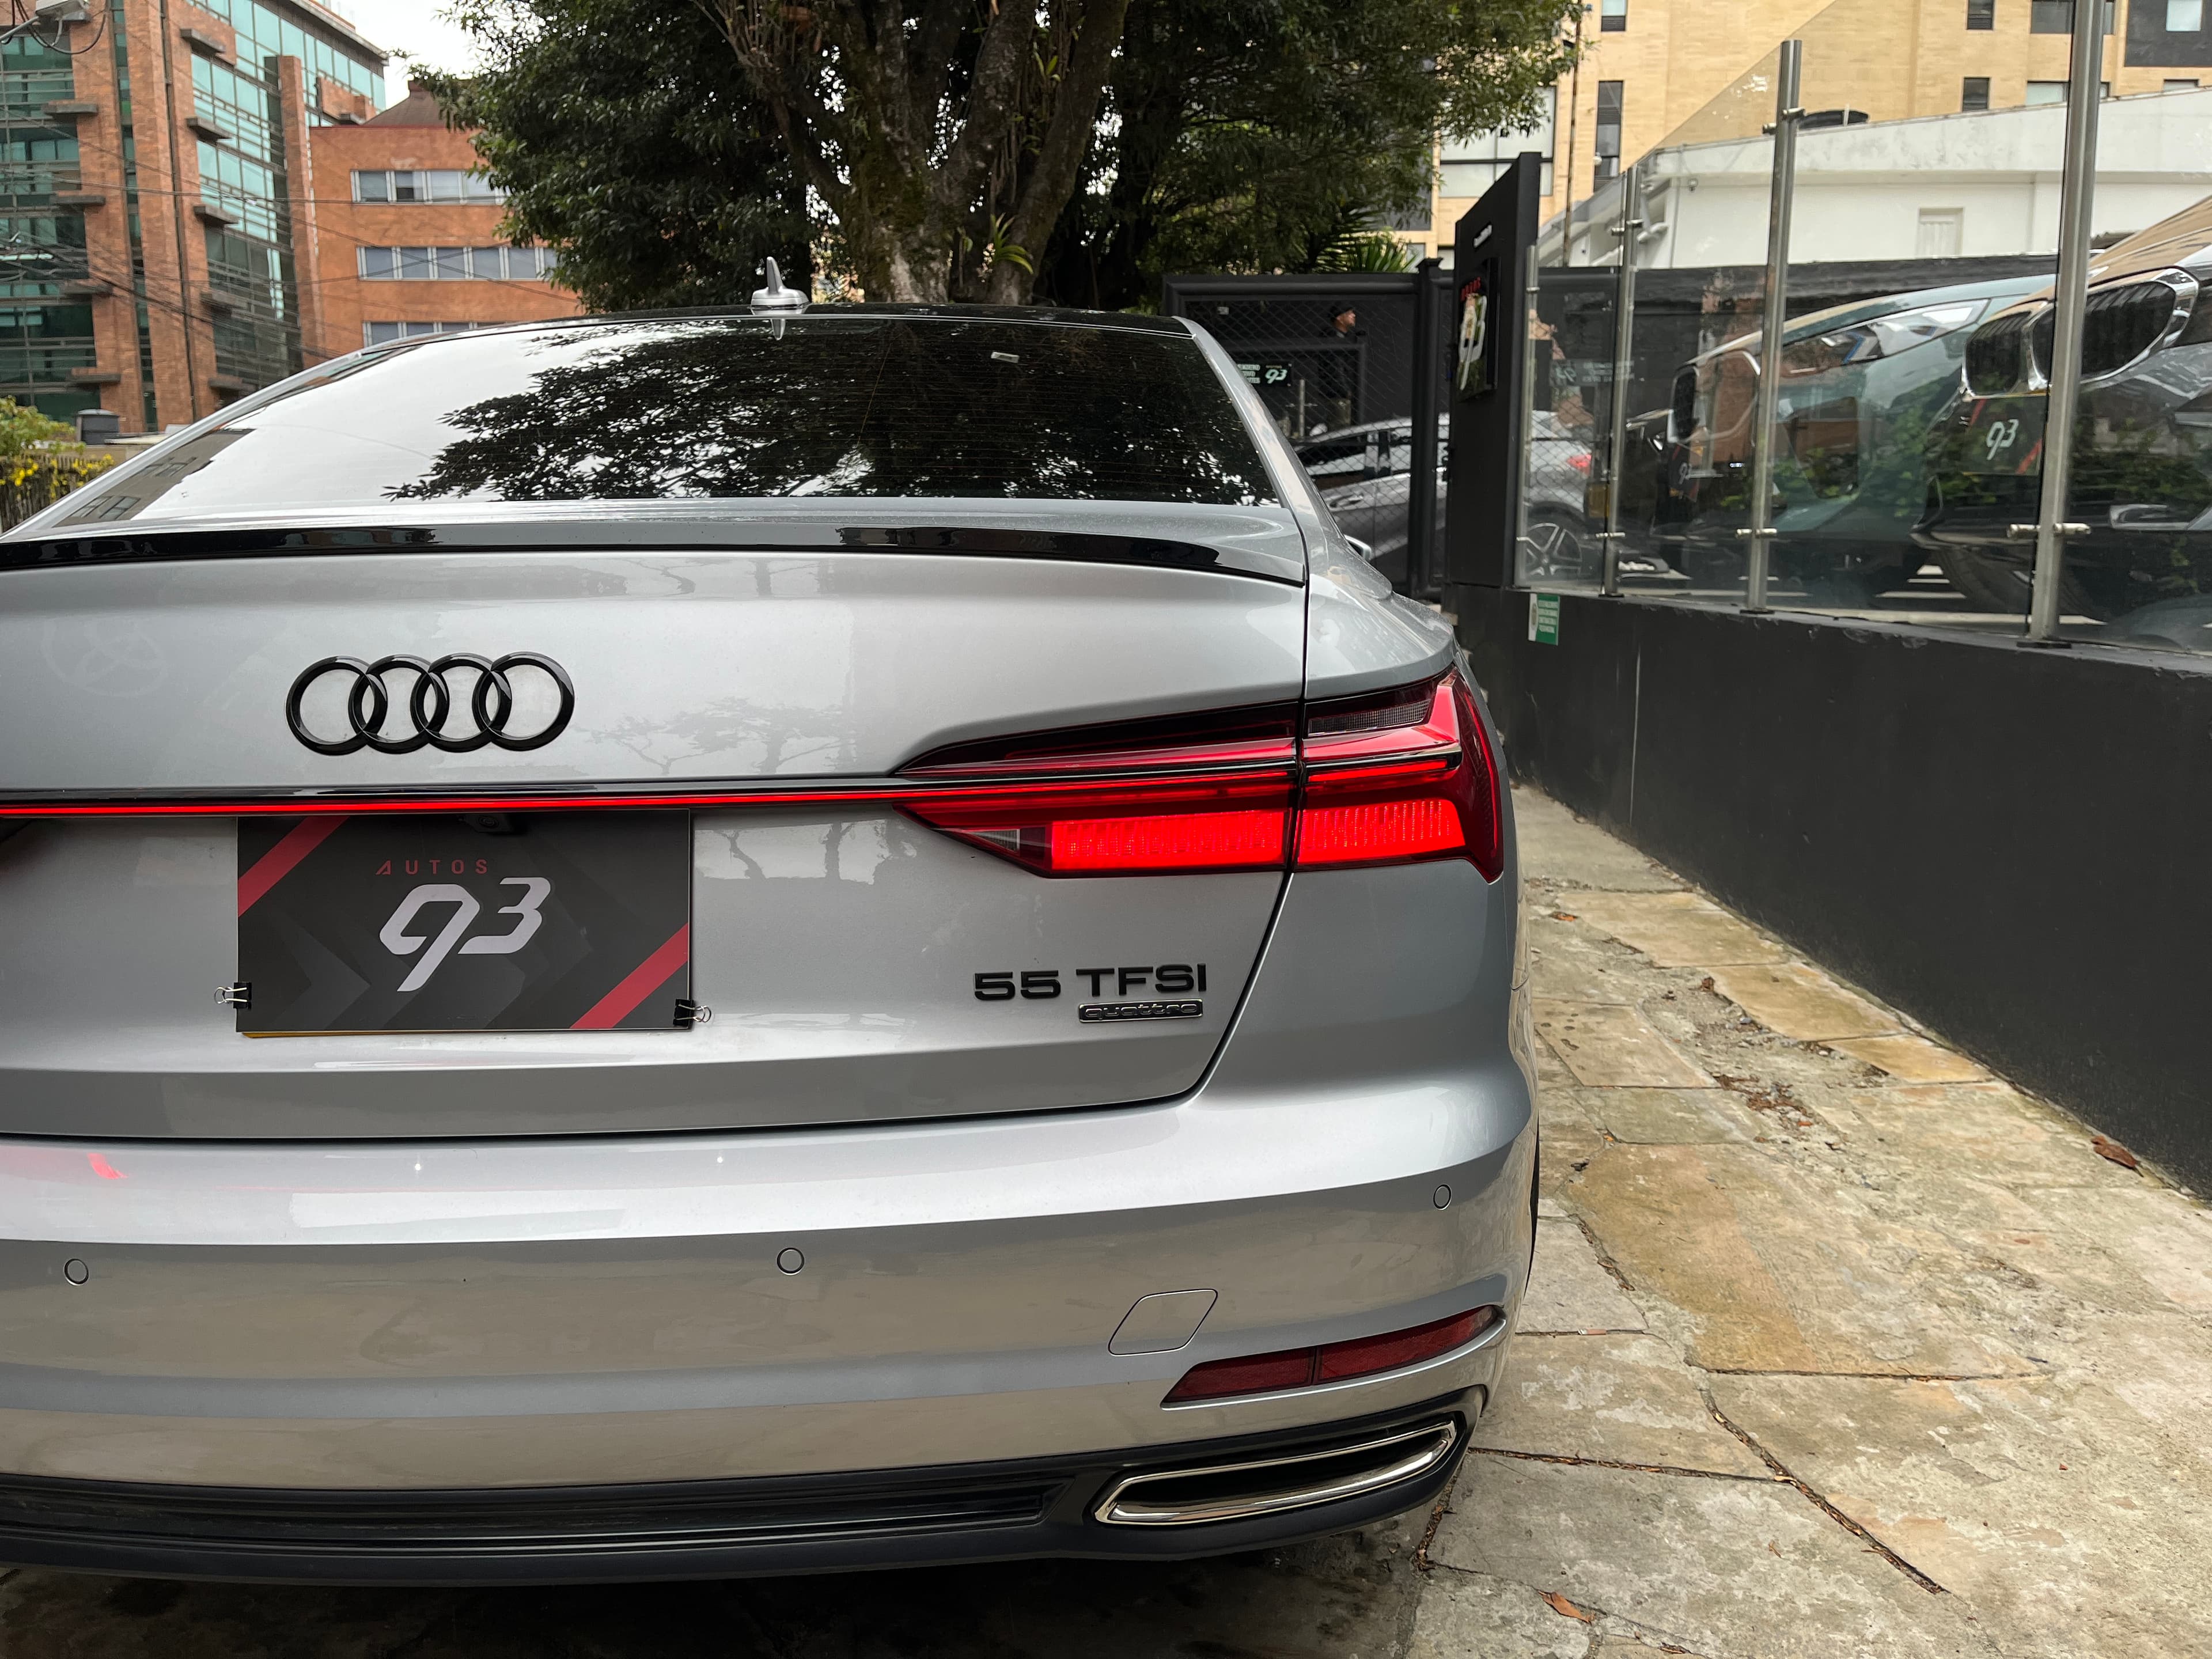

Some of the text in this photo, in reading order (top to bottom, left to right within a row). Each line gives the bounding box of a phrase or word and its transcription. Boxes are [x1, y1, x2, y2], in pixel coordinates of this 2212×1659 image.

[1265, 369, 1288, 384] 93
[1986, 419, 2019, 461] 93
[375, 858, 488, 876] AUTOS
[379, 877, 551, 992] 93
[974, 963, 1207, 1001] 55 TFSI
[1083, 1002, 1198, 1020] quattro
